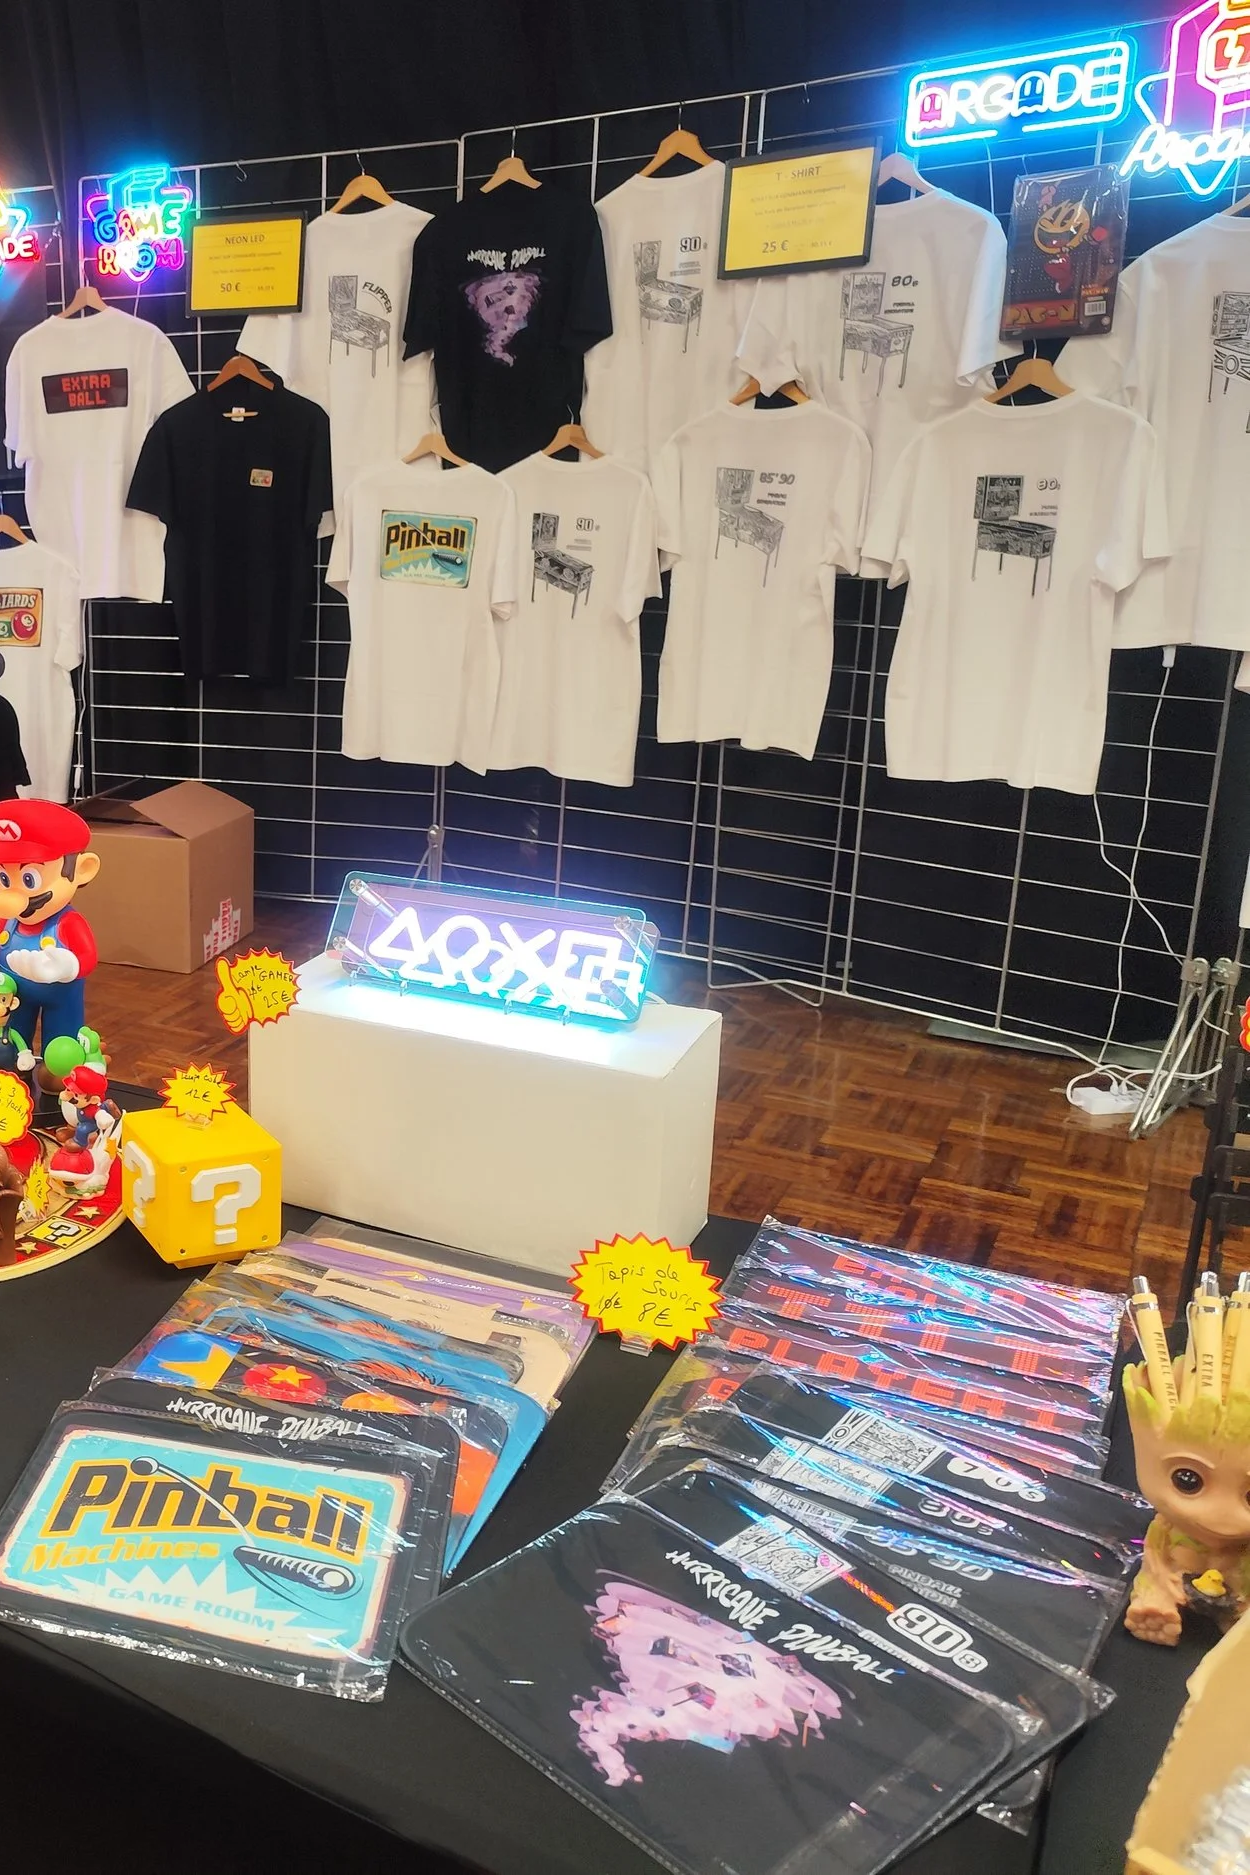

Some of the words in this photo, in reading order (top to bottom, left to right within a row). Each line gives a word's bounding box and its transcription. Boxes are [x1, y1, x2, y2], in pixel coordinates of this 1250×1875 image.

[791, 165, 822, 180] SHIRT
[225, 234, 248, 244] NEON
[250, 233, 265, 242] LED
[762, 241, 777, 253] 25
[781, 240, 789, 252] €
[220, 282, 232, 292] 50
[362, 281, 393, 314] FLIPPER
[62, 374, 111, 393] EXTRA
[68, 390, 106, 407] BALL
[385, 522, 466, 556] Pinball
[23, 616, 32, 624] 3
[185, 1089, 212, 1102] 12€
[595, 1261, 645, 1285] Tapis
[655, 1264, 680, 1283] de
[727, 1327, 1004, 1418] PLAYER
[1201, 1353, 1214, 1388] EXTRA
[167, 1397, 268, 1436] HURRICANE
[277, 1415, 366, 1442] PINBALL
[39, 1456, 375, 1565] Pinball
[22, 1536, 221, 1575] Machines
[888, 1564, 964, 1599] PINBALL
[108, 1585, 188, 1611] GAME
[193, 1598, 276, 1633] ROOM
[665, 1549, 780, 1632] HURRICANE
[774, 1623, 906, 1686] PINBALL
[886, 1602, 989, 1673] 90s
